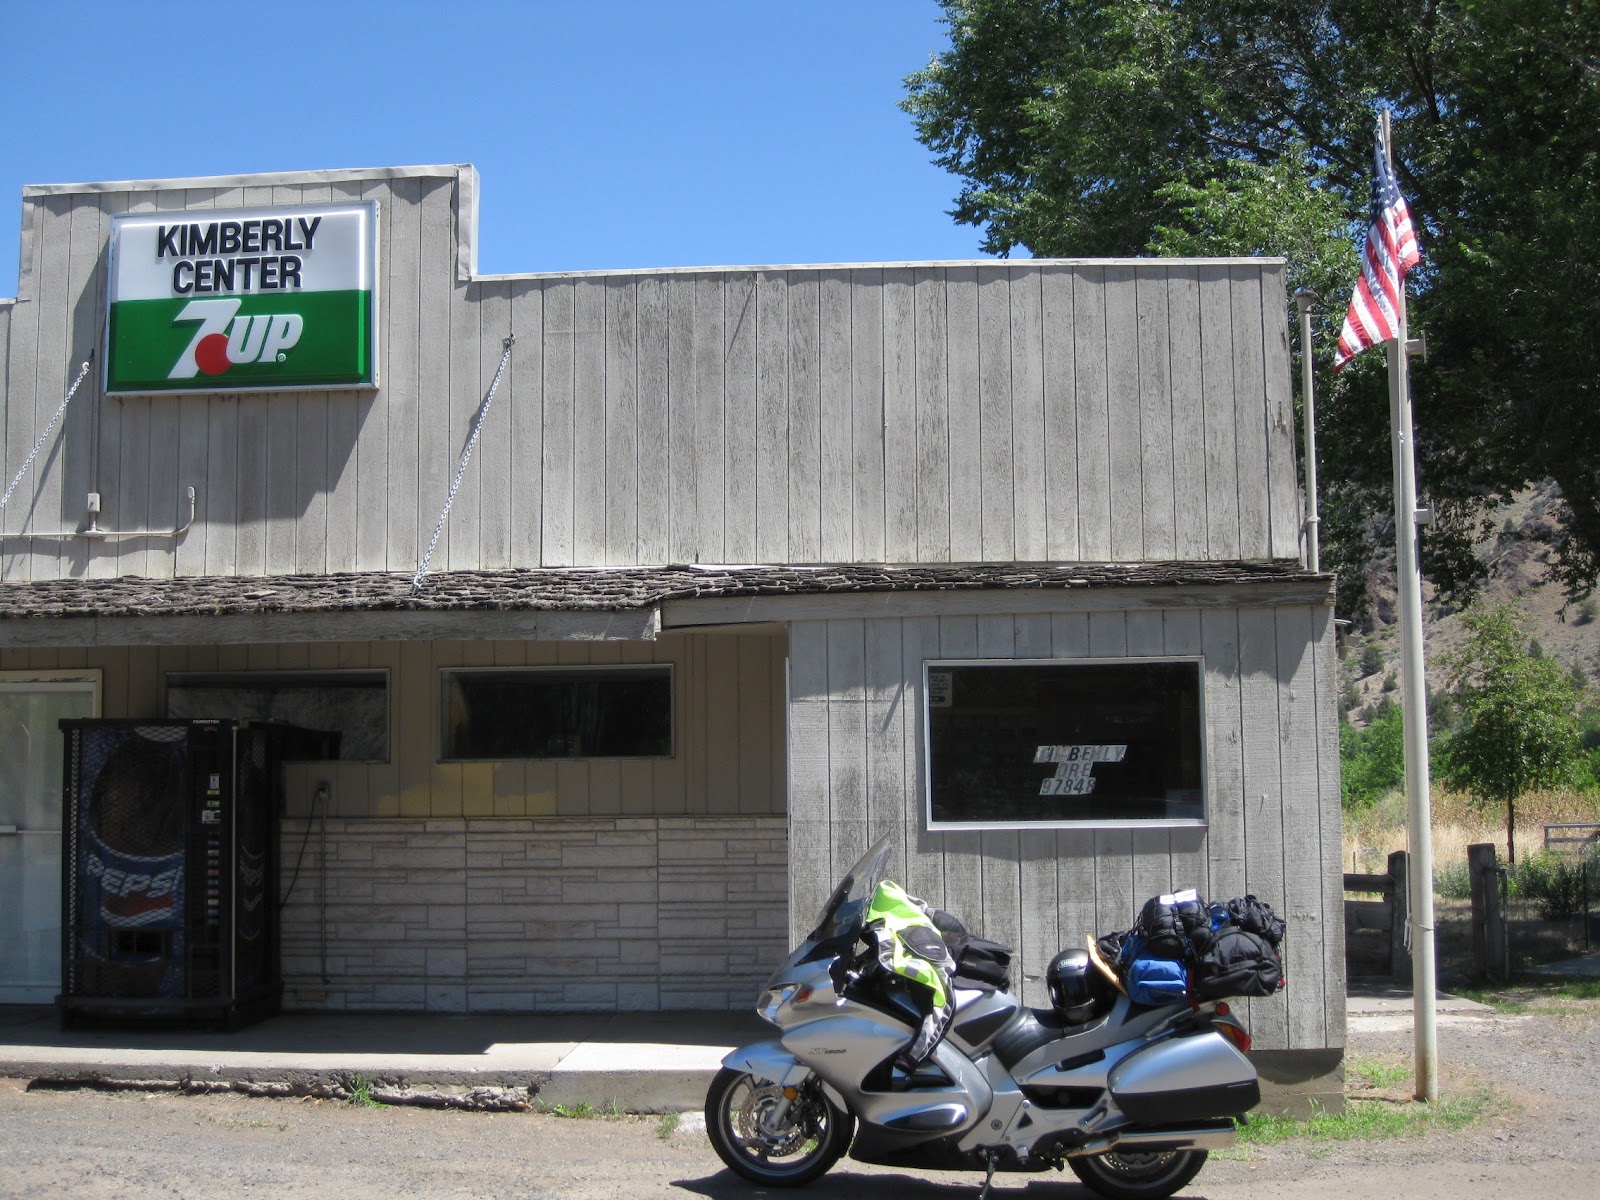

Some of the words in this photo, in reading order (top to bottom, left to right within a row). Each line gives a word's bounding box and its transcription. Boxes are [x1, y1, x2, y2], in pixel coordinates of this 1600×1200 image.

[158, 216, 322, 257] KIMBERLY
[173, 256, 302, 294] CENTER
[1036, 746, 1126, 761] IBELY
[1041, 779, 1095, 794] 97848
